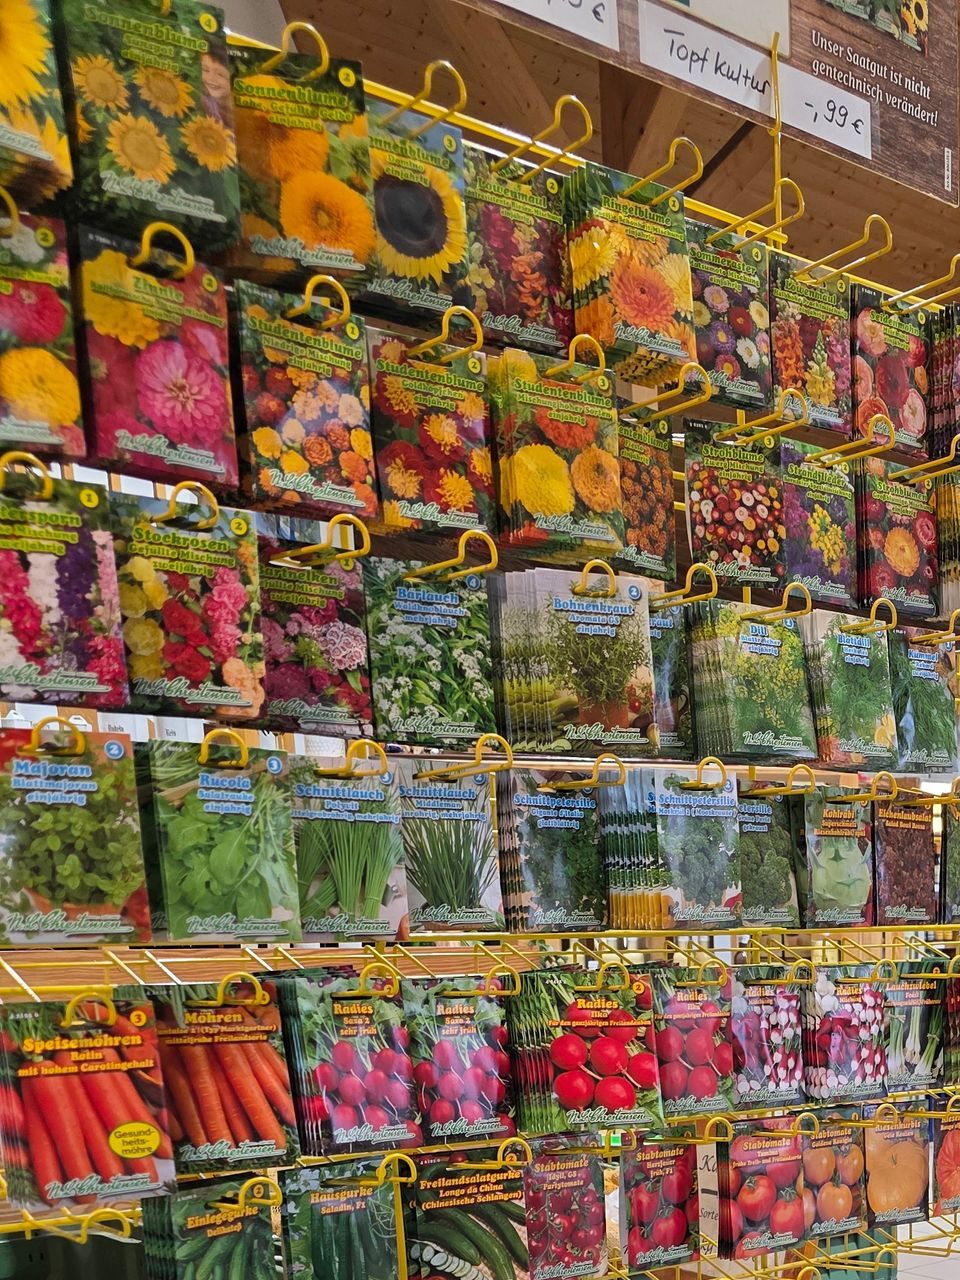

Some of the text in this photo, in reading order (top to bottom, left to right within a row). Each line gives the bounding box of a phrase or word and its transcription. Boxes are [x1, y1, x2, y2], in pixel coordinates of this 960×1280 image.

[84, 5, 209, 52] Sonnenblume
[811, 31, 932, 100] Unser Saatgut ist nicht
[234, 78, 348, 107] Sonnenblume
[811, 58, 938, 127] gentechnisch verändert!
[850, 118, 865, 135] €
[602, 195, 672, 227] Ringelblume
[690, 248, 757, 275] Sommeraster
[870, 310, 920, 335] Seidenmohn
[249, 317, 363, 360] Studentenblume
[377, 358, 485, 392] Studentenblume
[513, 377, 613, 408] Studentenblume
[702, 446, 766, 464] Strohblume
[788, 463, 847, 488] Strandflieder
[876, 481, 928, 500] Strohblumen
[133, 527, 229, 552] Stockrosen
[179, 550, 235, 567] Mischung
[396, 587, 460, 605] Bärlauch
[393, 601, 467, 616] Waldknoblauch
[552, 597, 635, 617] Bohnenkraut
[569, 613, 607, 625] Aromata
[750, 624, 769, 637] Dill
[13, 760, 93, 777] Majoran
[11, 777, 98, 792] Blattmajoran
[199, 774, 252, 790] Rucola
[196, 789, 256, 802] Salatrauke
[295, 784, 385, 801] Schnittlauch
[400, 785, 477, 799] Schnittlauch
[658, 793, 736, 806] Schnittpetersilie
[415, 800, 462, 810] Middleman
[513, 793, 596, 810] Schnittpetersilie
[822, 808, 855, 821] Kohlrabi
[878, 808, 932, 823] Eichenlaubsalat
[886, 980, 938, 992] Lauchzwiebel
[576, 998, 618, 1010] Radies
[676, 991, 708, 1002] Radies
[333, 1003, 374, 1016] Radies
[436, 1004, 475, 1016] Radies
[183, 1011, 244, 1025] Möhren
[340, 1026, 378, 1037] sehr früh
[22, 1033, 142, 1052] Speisemöhren
[70, 1050, 104, 1062] Rotin
[17, 1058, 154, 1078] mit hohem Carotingehalt
[114, 1129, 155, 1140] Gesund-
[122, 1136, 150, 1146] heits-
[120, 1144, 153, 1155] möhre
[742, 1137, 791, 1151] Stabtomate
[636, 1147, 685, 1162] Stabtomate
[534, 1158, 589, 1173] Stabtomate
[419, 1170, 521, 1190] Freilandsalatgurke
[543, 1179, 584, 1191] Partytomate
[310, 1186, 374, 1204] Hausgurke
[439, 1183, 504, 1198] Longo da China
[421, 1190, 522, 1211] (Chinesische Schlangen)
[186, 1205, 259, 1228] Einlegegurke
[320, 1204, 353, 1215] Saladin,
